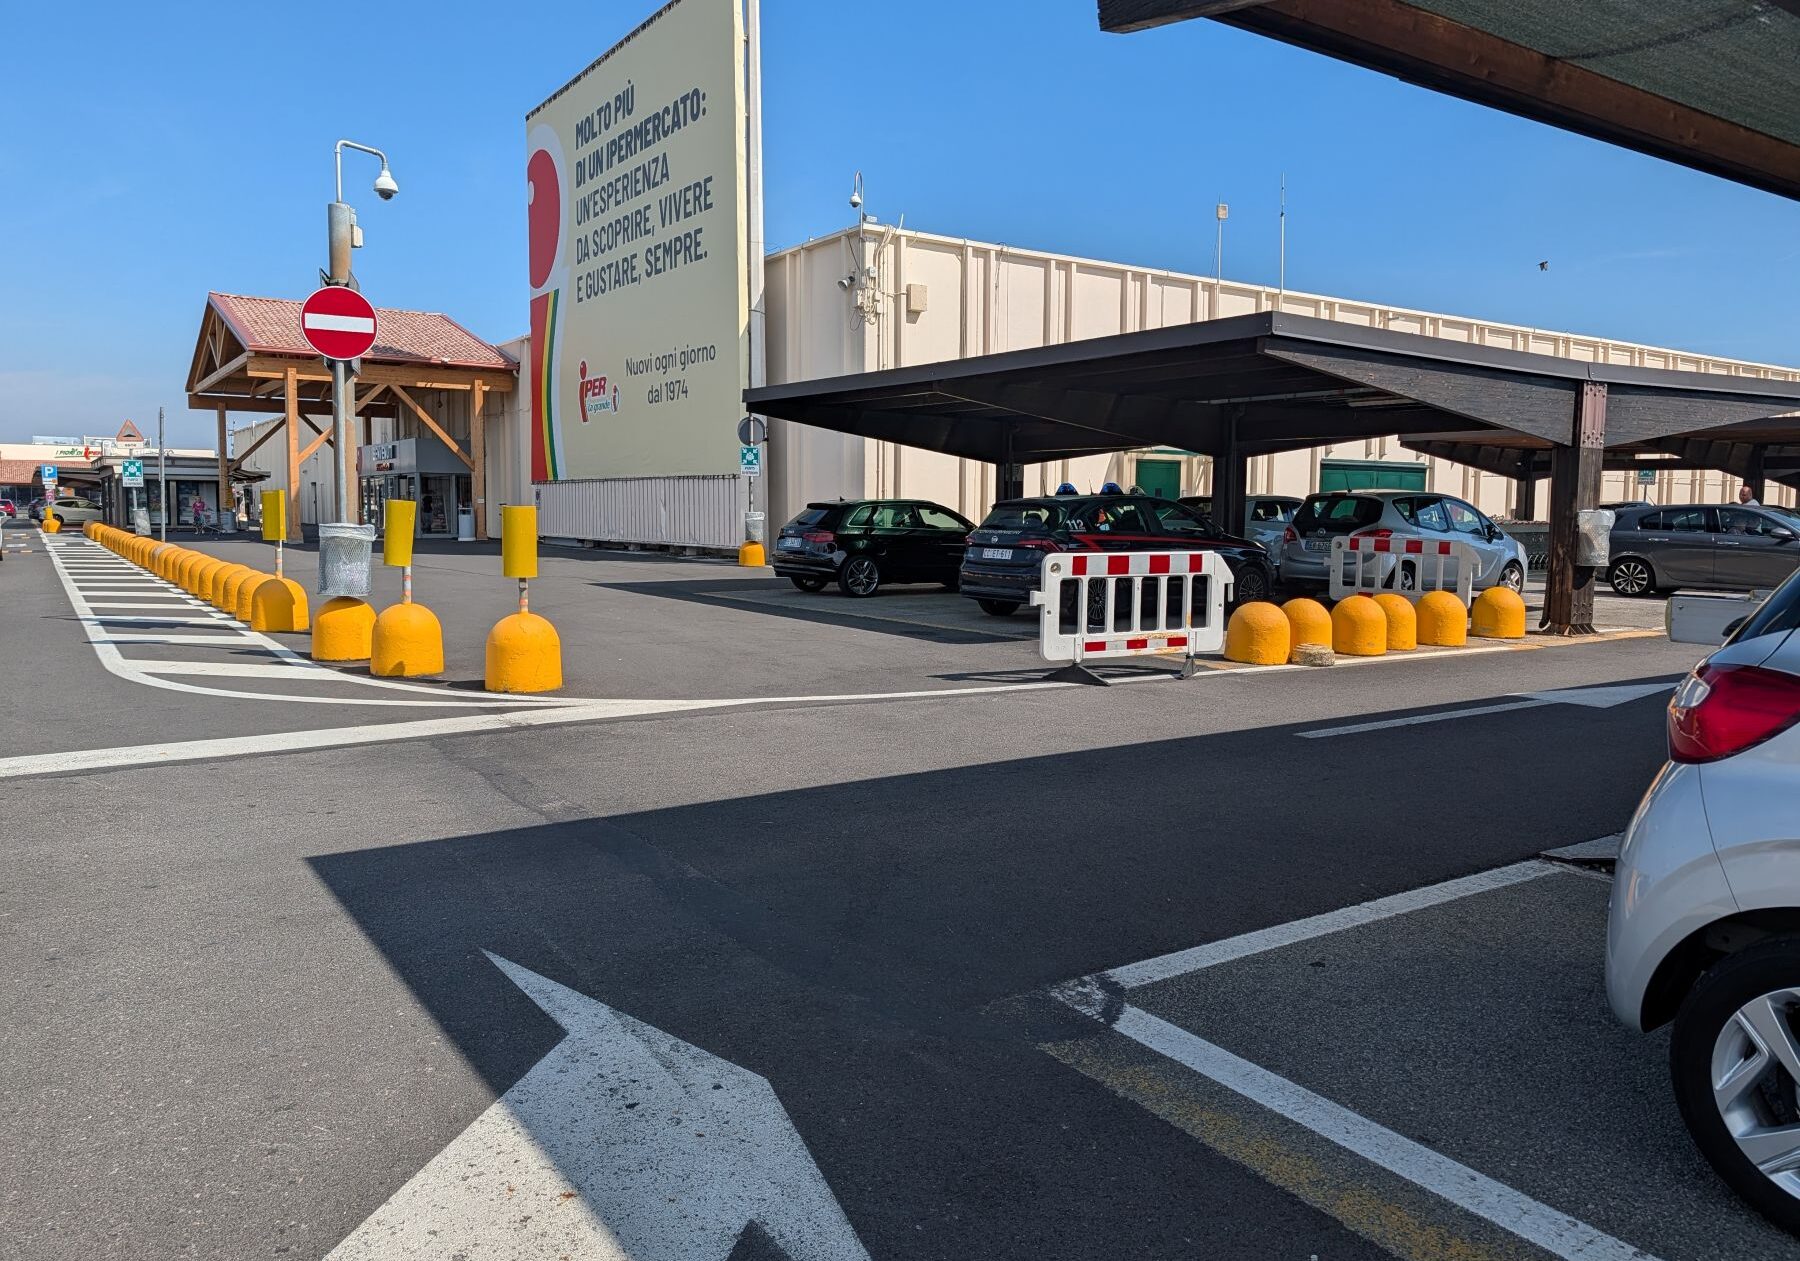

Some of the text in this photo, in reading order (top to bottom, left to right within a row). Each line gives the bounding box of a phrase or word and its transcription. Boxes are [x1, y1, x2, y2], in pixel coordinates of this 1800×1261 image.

[575, 79, 635, 150] MOLTO PIÙ
[575, 87, 707, 189] DI UN IPERMERCATO:
[576, 151, 670, 226] UN'ESPERIENZA
[576, 175, 713, 265] DA SCOPRIRE, VIVERE
[577, 227, 708, 303] E GUSTARE, SEMPRE.
[625, 344, 716, 377] Nuovi ogni giorno
[593, 400, 610, 413] grande
[647, 379, 689, 404] dal 1974
[44, 466, 54, 478] P
[1066, 519, 1086, 530] 112
